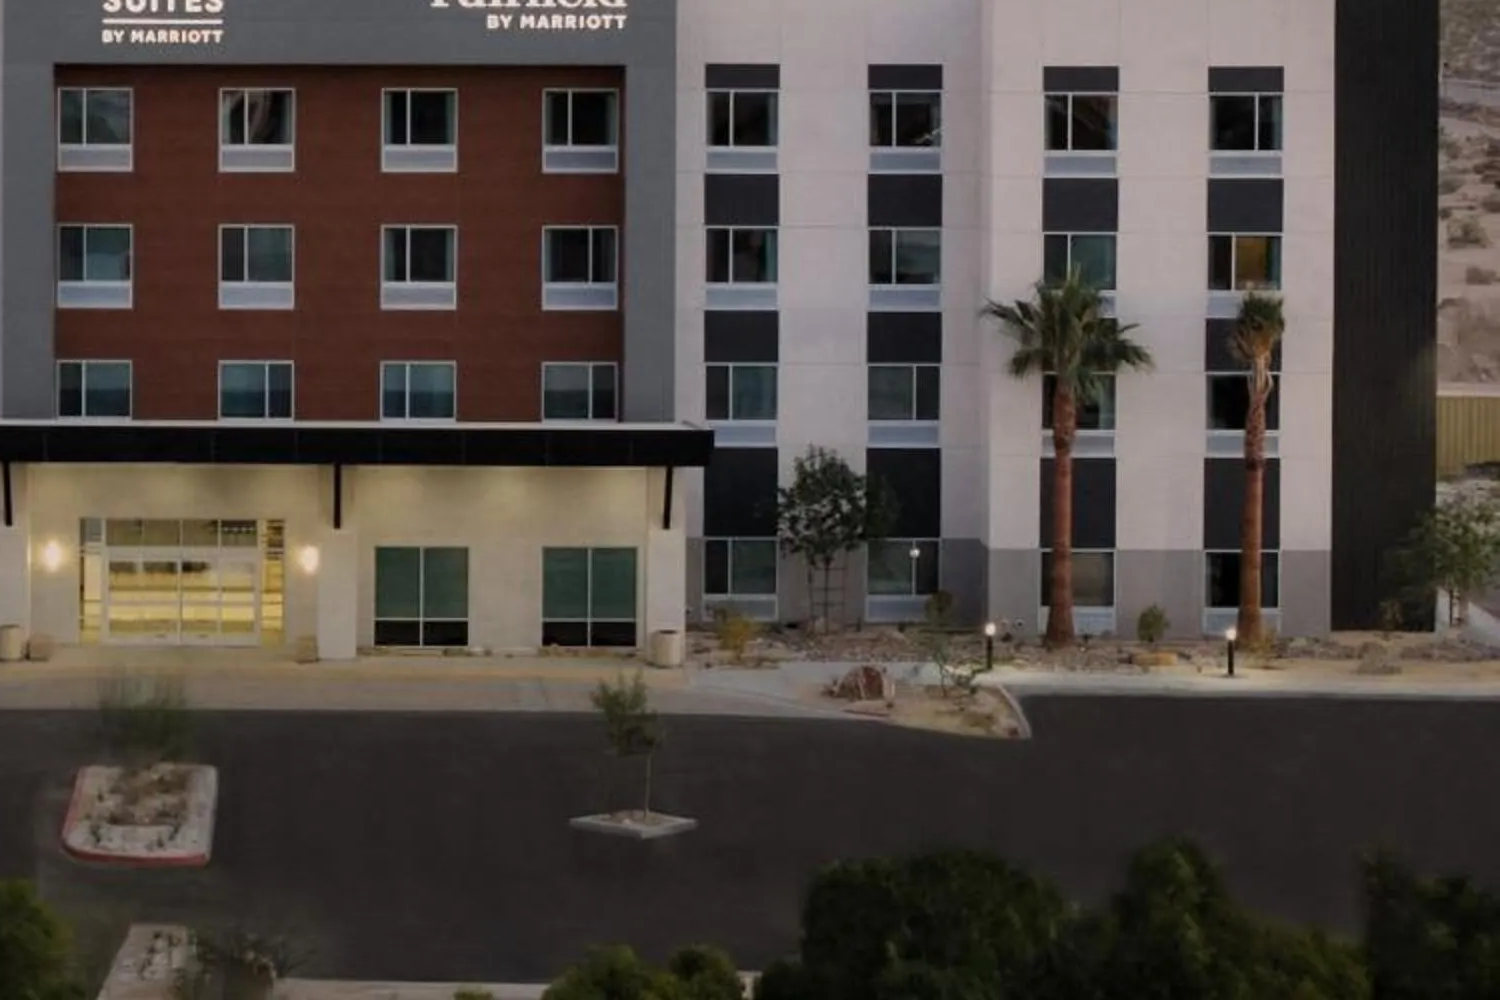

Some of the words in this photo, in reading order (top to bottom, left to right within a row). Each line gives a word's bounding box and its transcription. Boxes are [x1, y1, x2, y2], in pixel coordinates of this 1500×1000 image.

[487, 13, 513, 30] BY
[519, 13, 628, 31] MARRIOTT
[101, 28, 126, 44] BY
[129, 28, 224, 44] MARRIOTT
